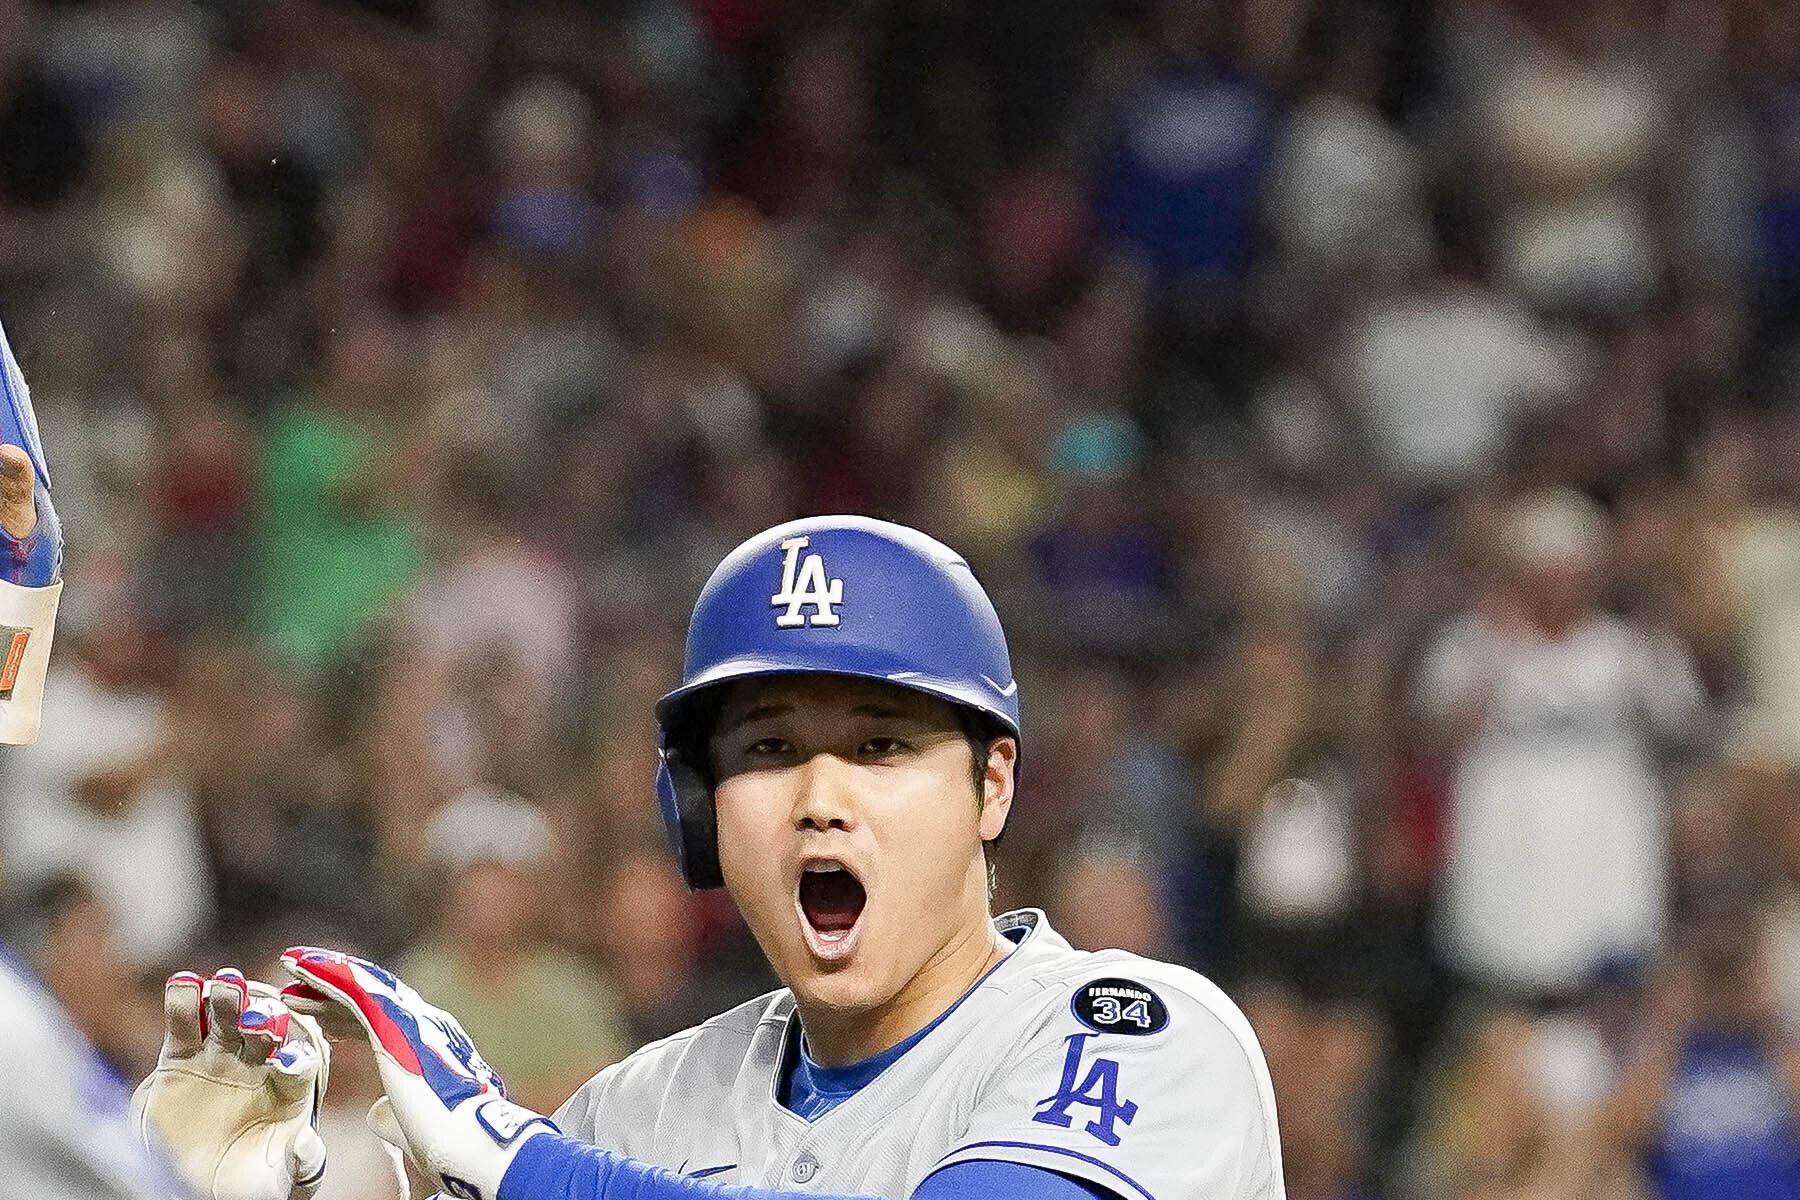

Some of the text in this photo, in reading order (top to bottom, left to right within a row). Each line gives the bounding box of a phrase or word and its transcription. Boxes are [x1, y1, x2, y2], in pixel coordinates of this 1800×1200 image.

[771, 536, 844, 627] LA
[1088, 987, 1152, 1002] FERNANDO
[1092, 997, 1152, 1029] 34
[1032, 1032, 1139, 1147] LA
